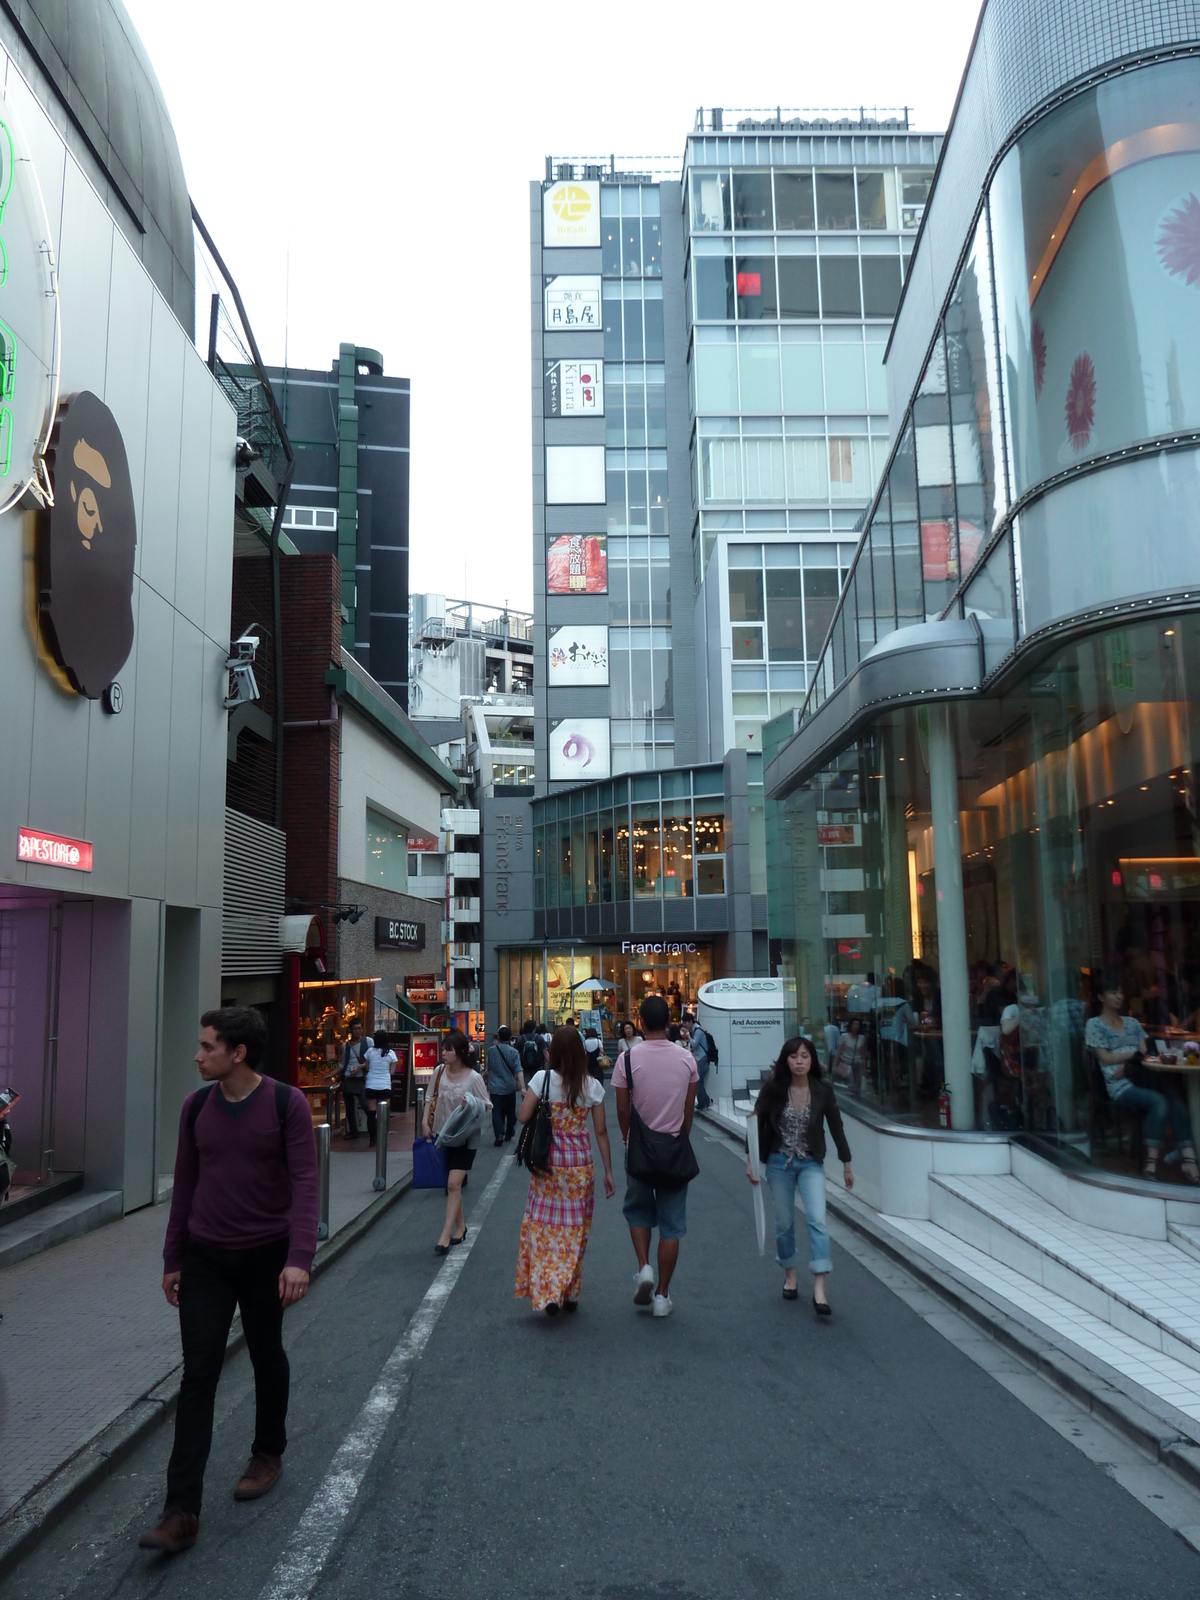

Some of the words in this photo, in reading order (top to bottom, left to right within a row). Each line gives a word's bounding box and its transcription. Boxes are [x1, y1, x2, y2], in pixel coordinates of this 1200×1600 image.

[552, 304, 594, 324] 月島屋
[565, 364, 577, 410] Kirara
[569, 535, 581, 575] 食べ放題
[515, 813, 523, 851] SHIBUYA
[496, 814, 512, 917] Francfranc
[399, 922, 418, 941] STOCK
[621, 940, 696, 953] Francfranc
[720, 981, 778, 993] PARCO
